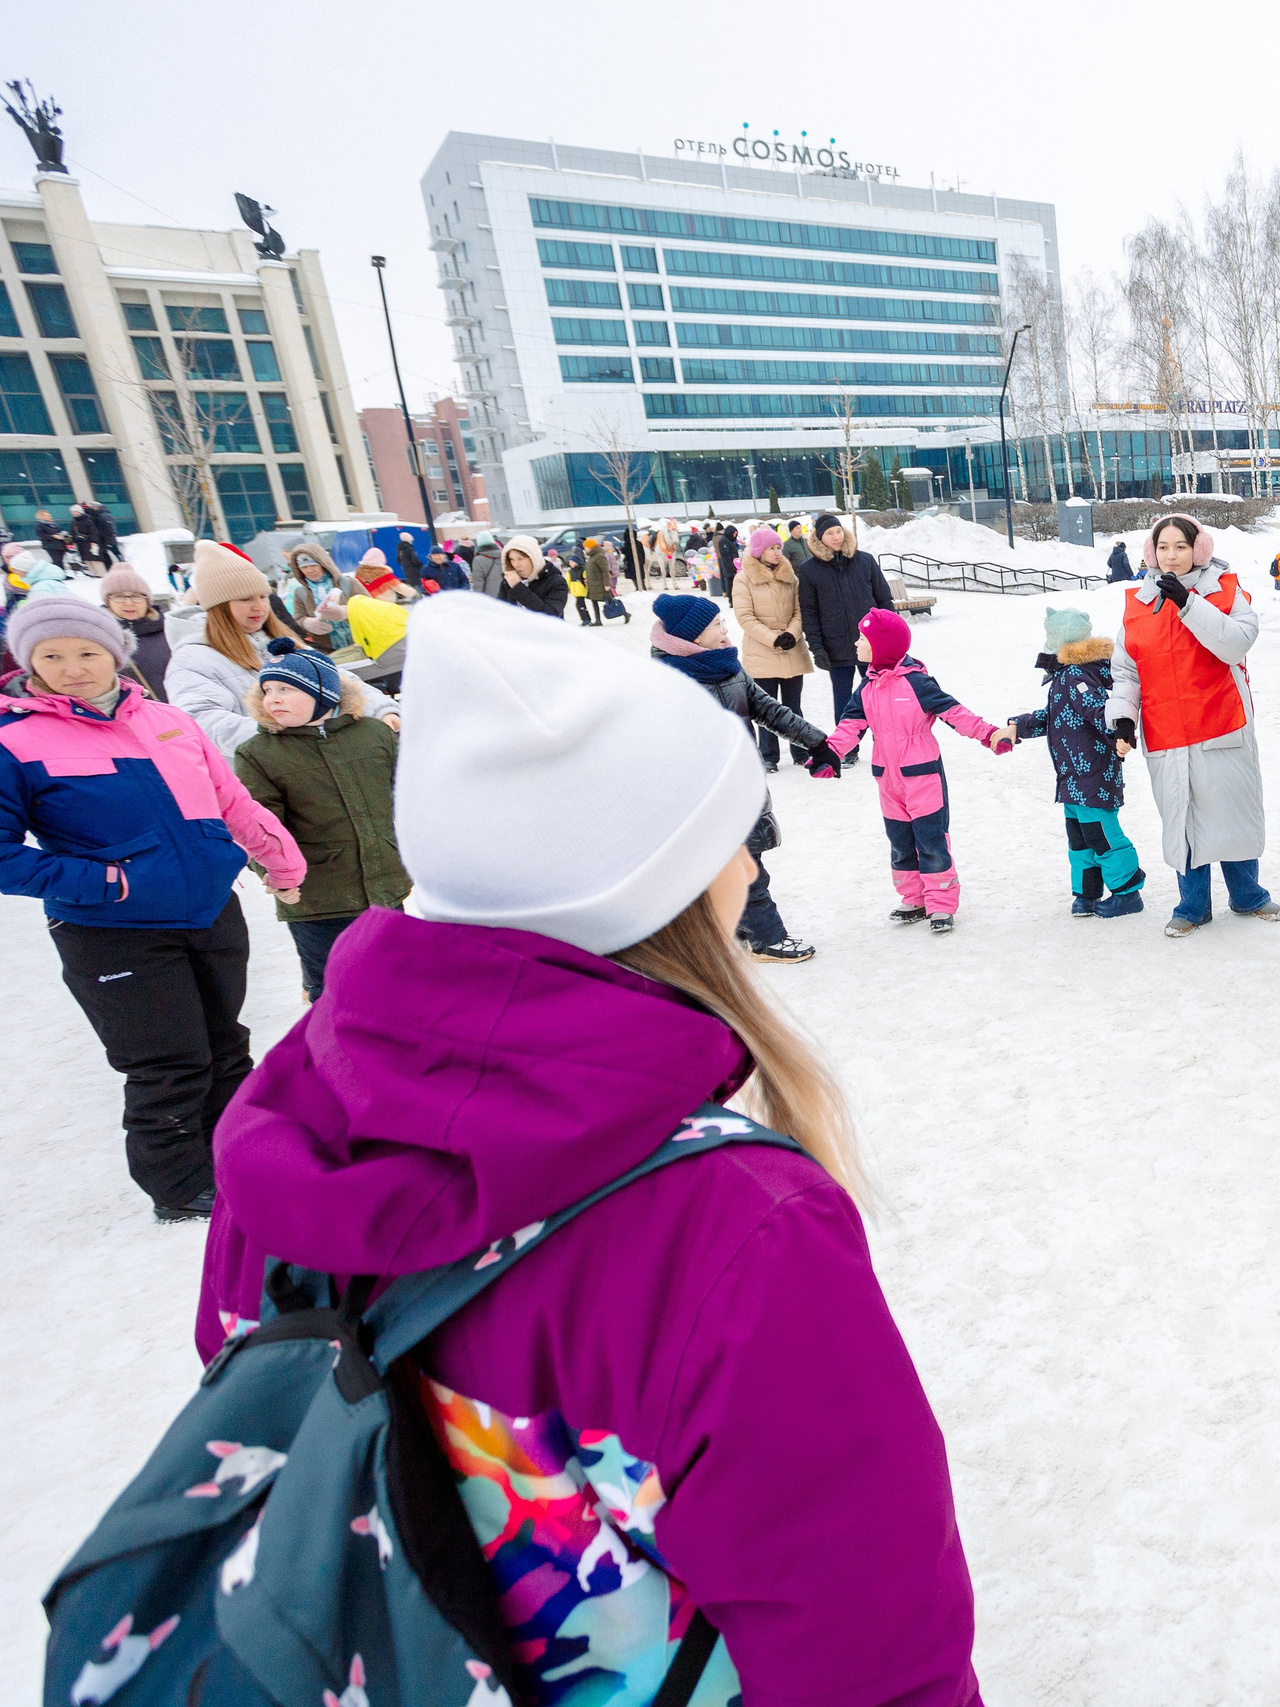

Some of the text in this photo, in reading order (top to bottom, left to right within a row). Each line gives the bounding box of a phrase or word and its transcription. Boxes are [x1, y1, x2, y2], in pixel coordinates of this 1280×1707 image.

[674, 138, 727, 155] ОТЕЛЬ
[732, 137, 851, 170] COSMOS
[854, 162, 901, 177] HOTEL
